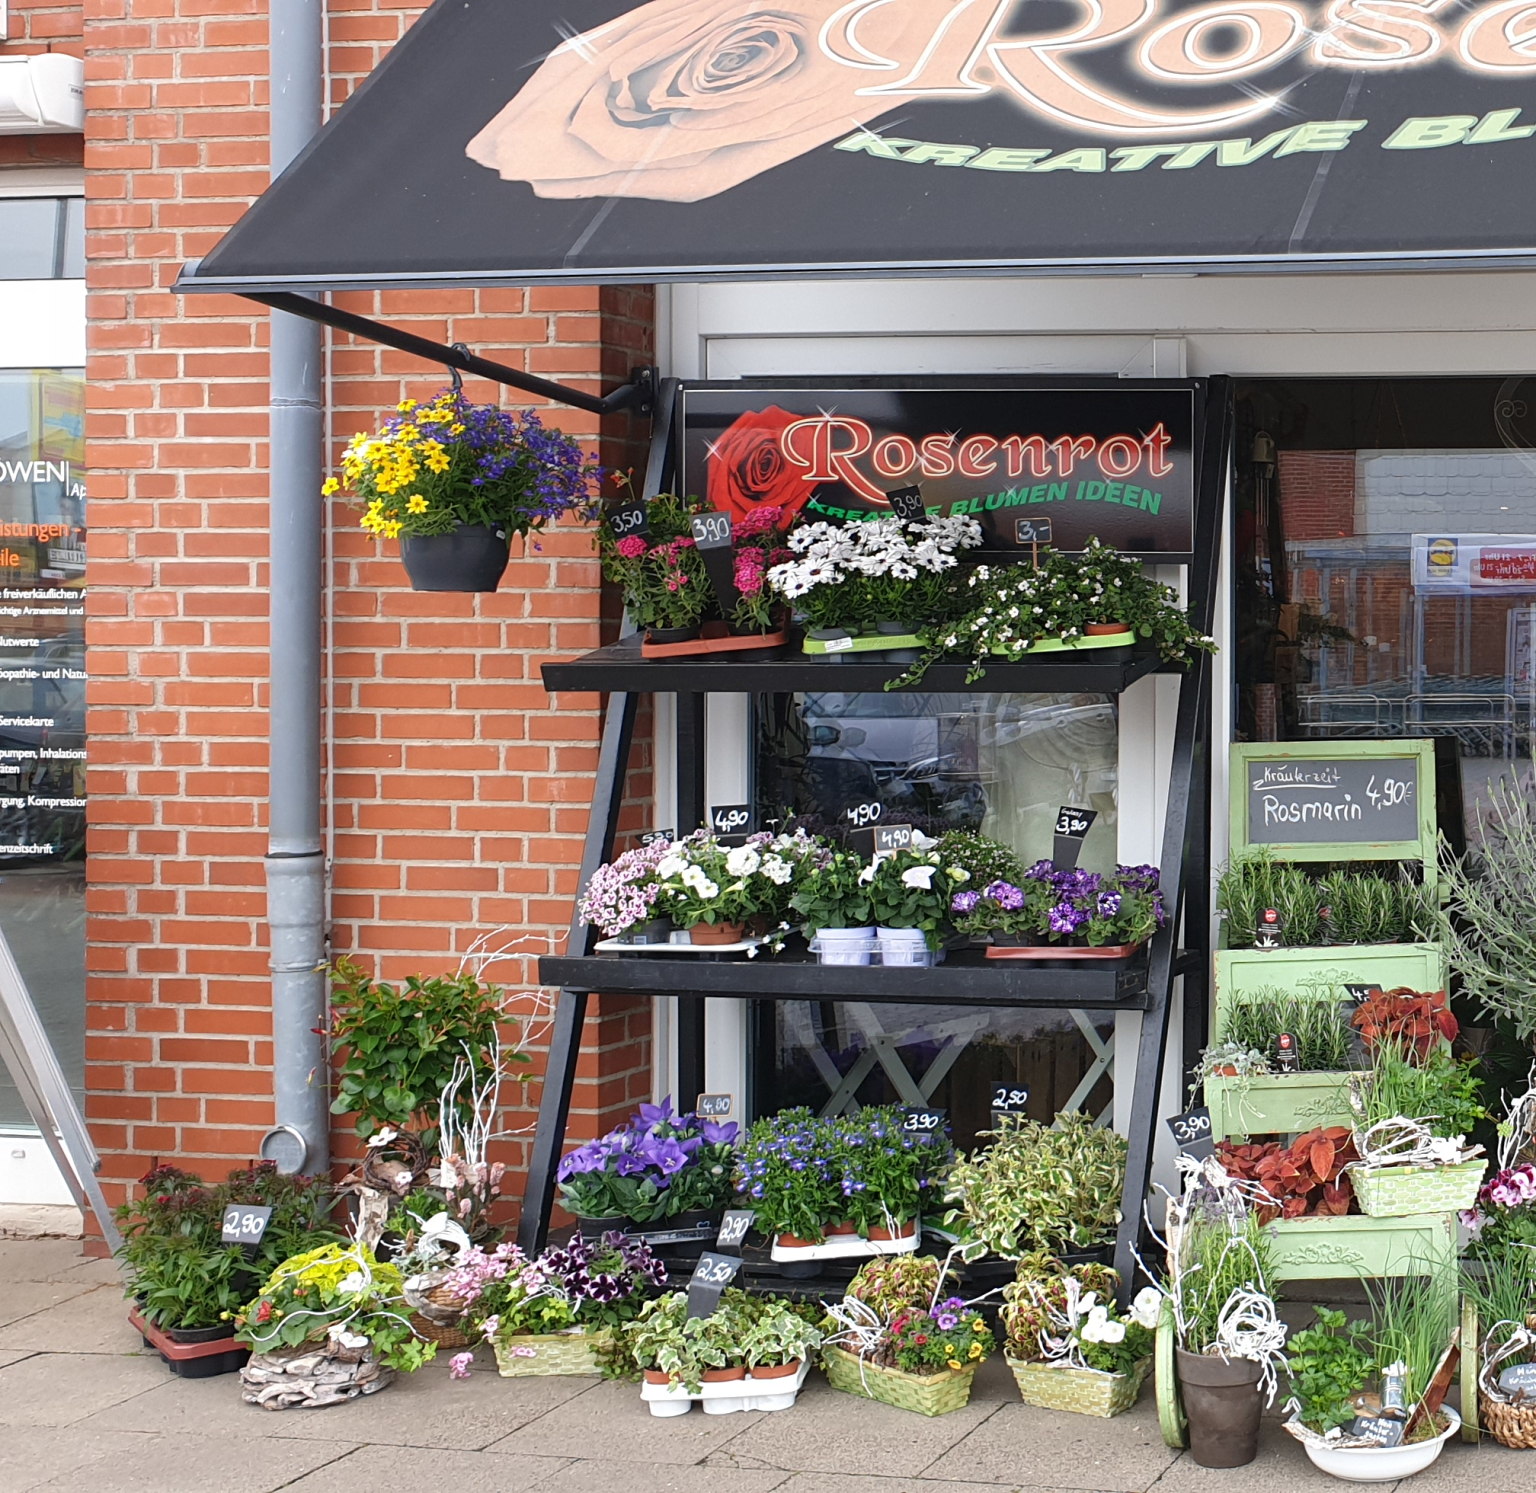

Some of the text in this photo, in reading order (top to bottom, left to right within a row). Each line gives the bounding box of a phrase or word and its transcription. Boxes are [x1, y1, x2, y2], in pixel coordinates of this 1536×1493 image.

[833, 120, 1368, 172] KREATIVE
[780, 415, 1174, 504] Rosenrot
[806, 480, 1162, 522] KREATE BLUMEN IDEEN
[893, 494, 923, 517] 3,90
[611, 510, 643, 533] 3,50
[692, 517, 730, 542] 3,90
[0, 547, 20, 567] ile
[42, 668, 60, 679] und
[715, 809, 749, 832] 4,90
[847, 802, 881, 826] 4,90
[1262, 793, 1362, 826] Rosmarin
[1055, 816, 1088, 835] 3,90
[881, 829, 910, 848] 4,90
[991, 1088, 1028, 1110] 2,50
[903, 1113, 939, 1131] 3,90
[1174, 1116, 1211, 1140] 3,90
[222, 1211, 265, 1238] 2,90
[719, 1215, 750, 1242] 2,90
[696, 1257, 732, 1282] 2,50
